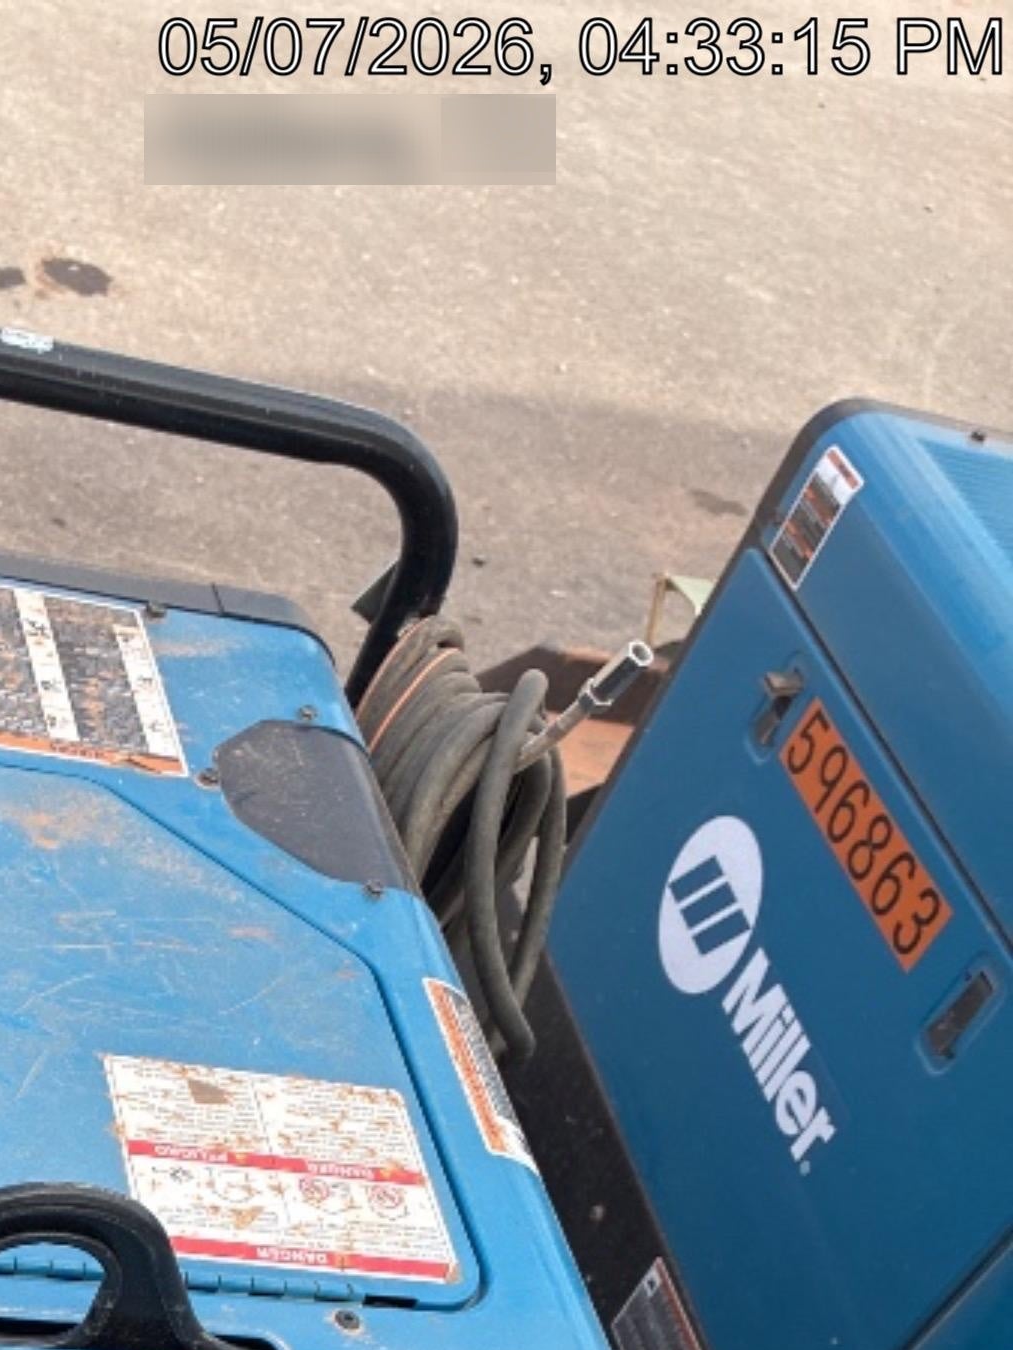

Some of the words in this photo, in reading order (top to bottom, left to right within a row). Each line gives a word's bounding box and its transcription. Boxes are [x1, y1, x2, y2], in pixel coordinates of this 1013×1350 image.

[787, 708, 941, 957] 596863
[721, 947, 836, 1163] Miller
[256, 1247, 328, 1265] DANGER
